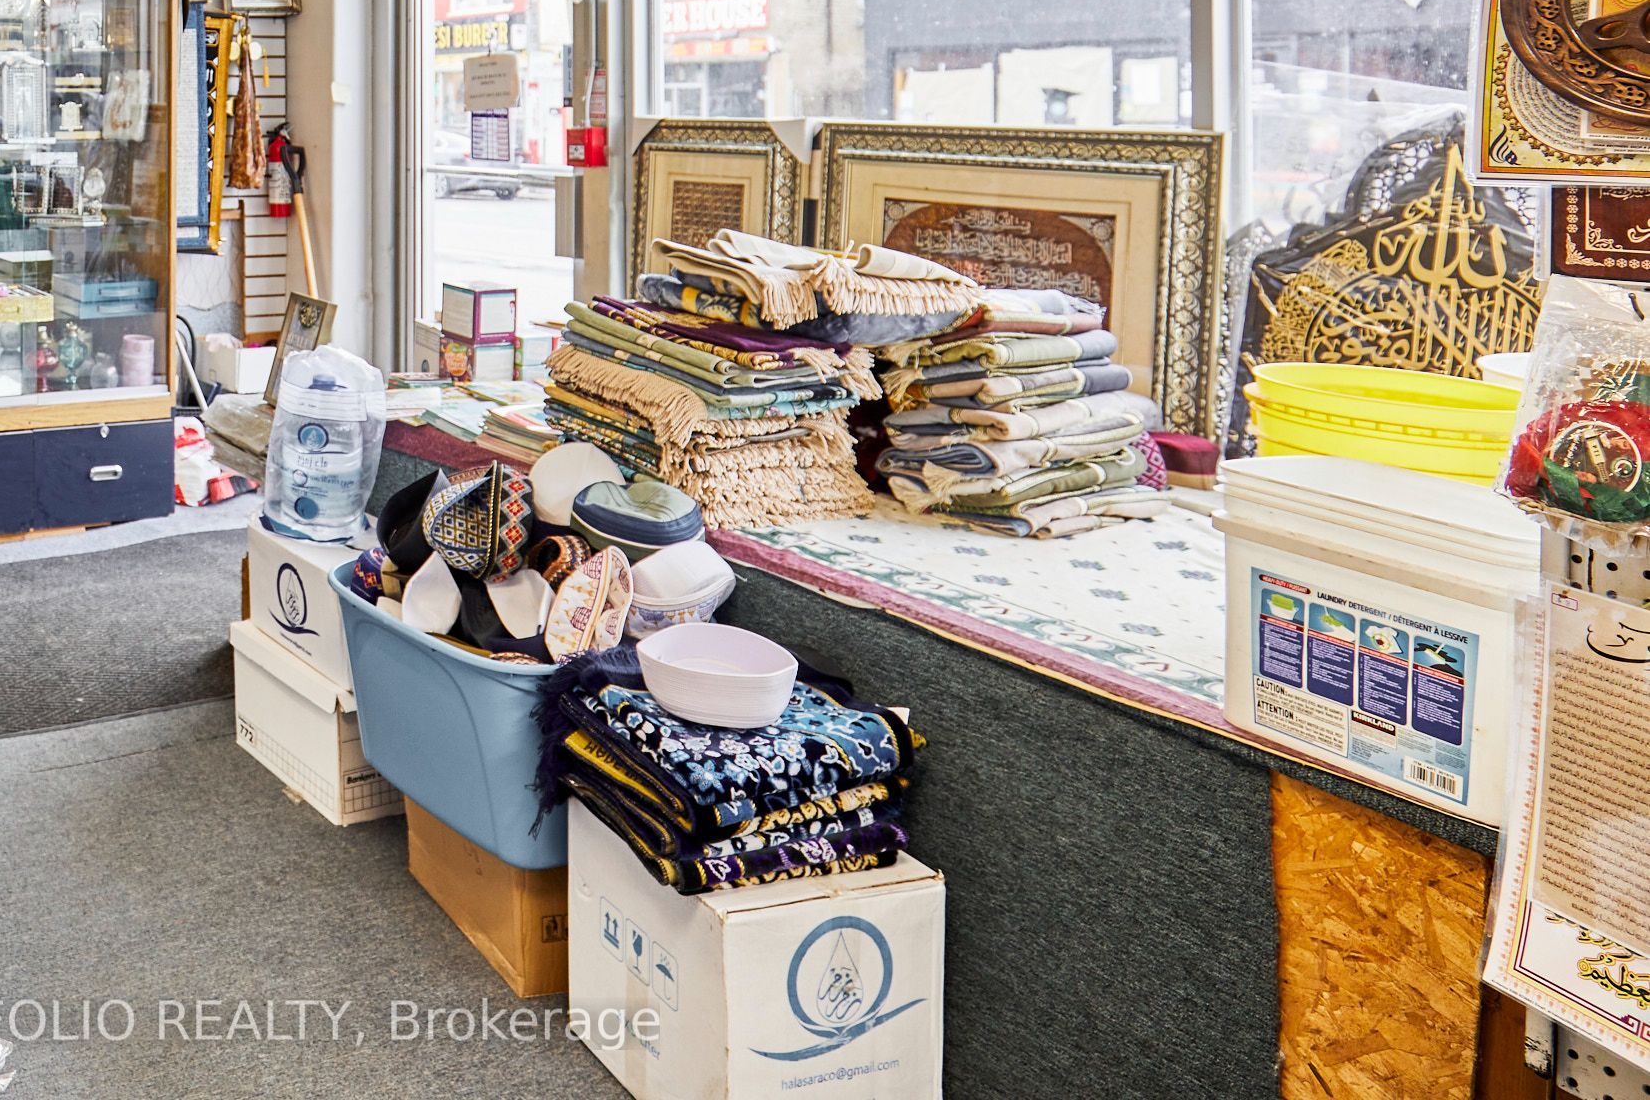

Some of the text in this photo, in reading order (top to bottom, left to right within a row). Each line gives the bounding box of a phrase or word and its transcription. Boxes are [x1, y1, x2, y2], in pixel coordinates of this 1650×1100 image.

[1317, 591, 1348, 606] LAUNDRY
[1348, 601, 1387, 620] DETERGENT
[1393, 613, 1433, 633] DÉTERGENT
[1434, 624, 1440, 636] À
[1440, 629, 1469, 644] LESSIVE
[1257, 699, 1294, 721] ATTENTION
[1352, 711, 1395, 732] KIRKLAND
[239, 723, 254, 743] 772
[781, 1057, 900, 1091] halasaraco@gmail.com
